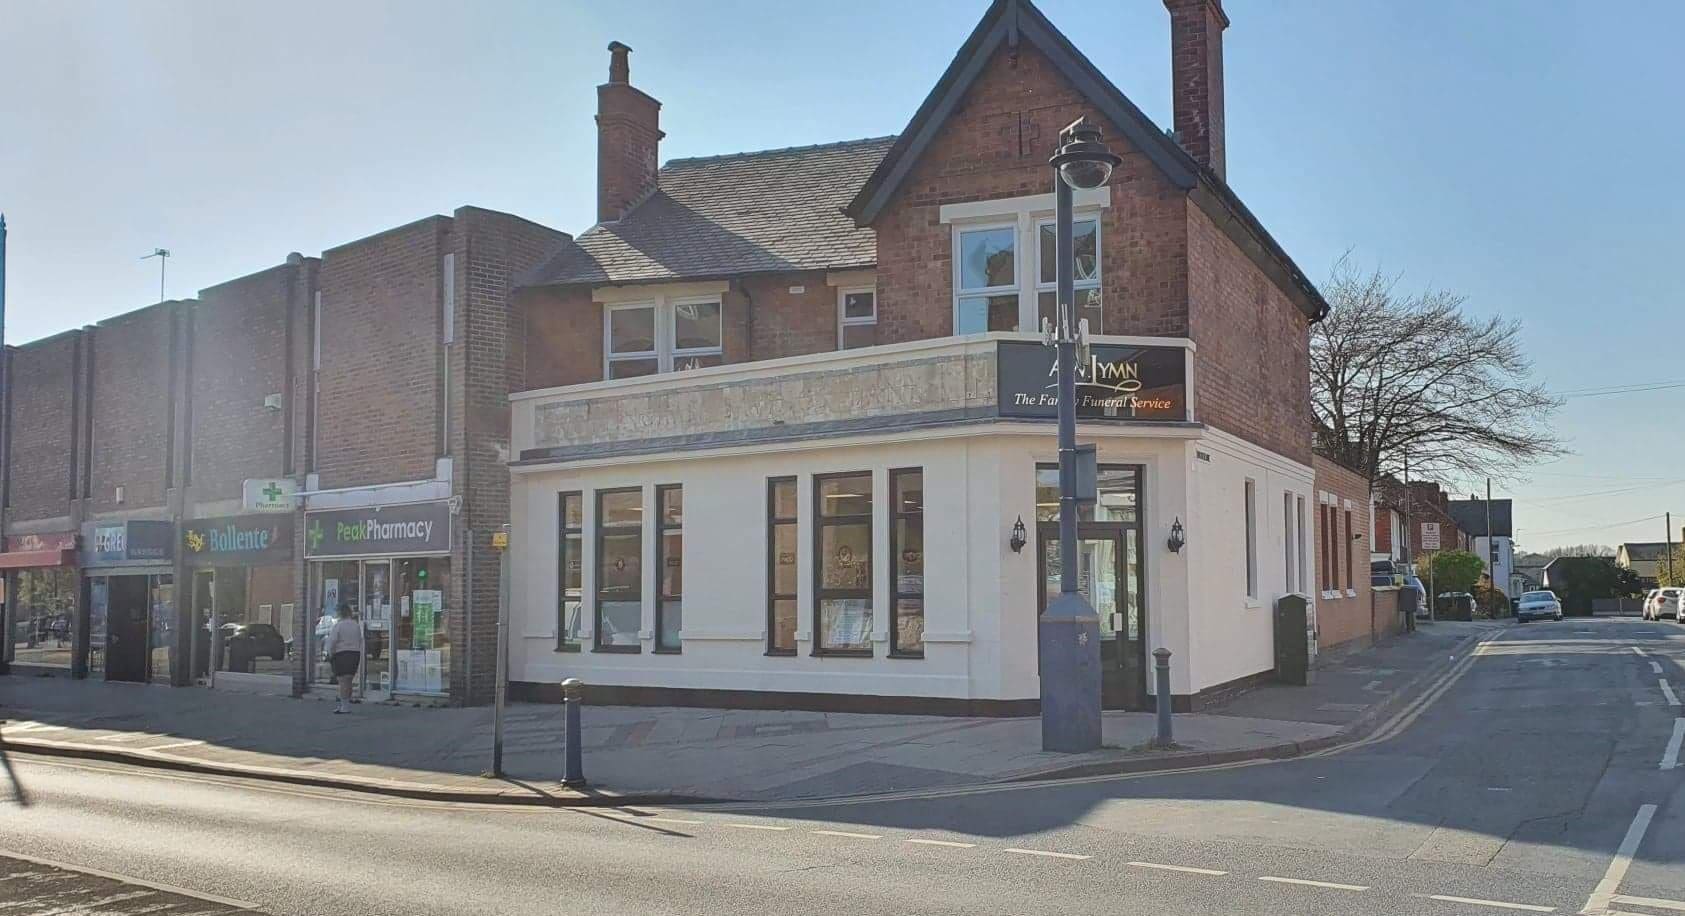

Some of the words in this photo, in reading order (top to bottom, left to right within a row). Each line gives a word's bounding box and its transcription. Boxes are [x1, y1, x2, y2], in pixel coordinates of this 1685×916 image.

[1015, 393, 1036, 406] The
[1082, 395, 1127, 408] Funeral
[1130, 396, 1172, 410] Service
[337, 519, 433, 542] PeakPharmacy
